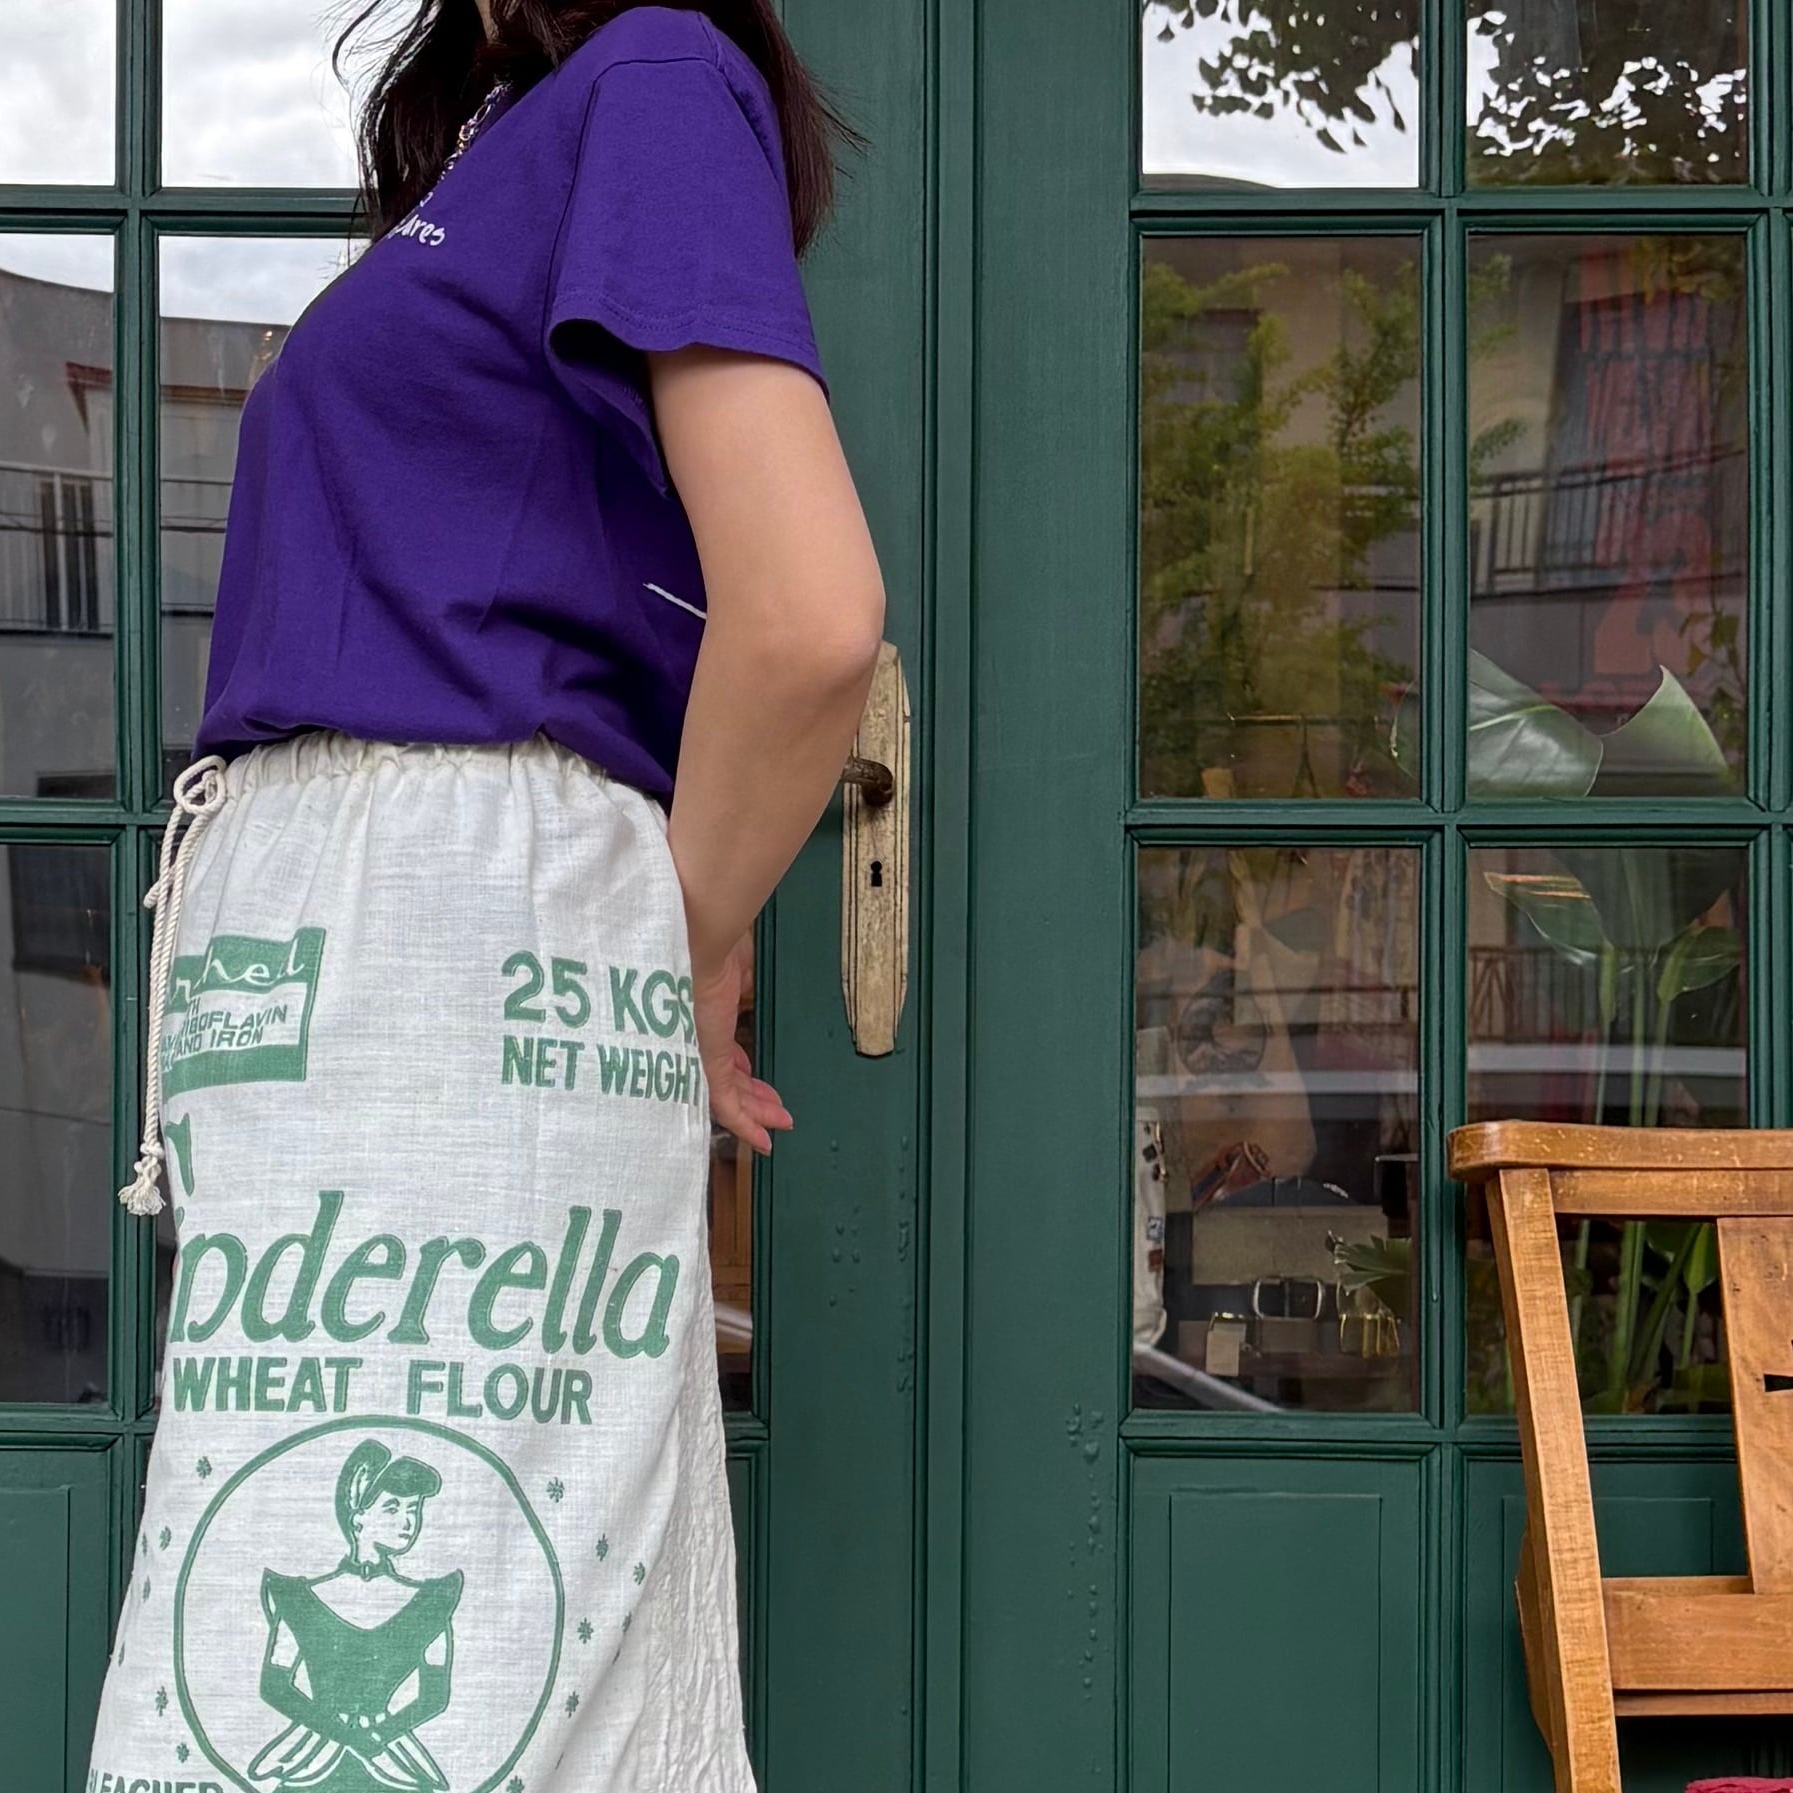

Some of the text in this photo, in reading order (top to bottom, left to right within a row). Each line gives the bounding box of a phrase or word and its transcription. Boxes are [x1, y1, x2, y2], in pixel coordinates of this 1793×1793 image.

[502, 951, 591, 1029] 25
[210, 1026, 263, 1048] IRON
[502, 1035, 701, 1106] NET WEIGHT
[172, 1357, 593, 1424] WHEAT FLOUR
